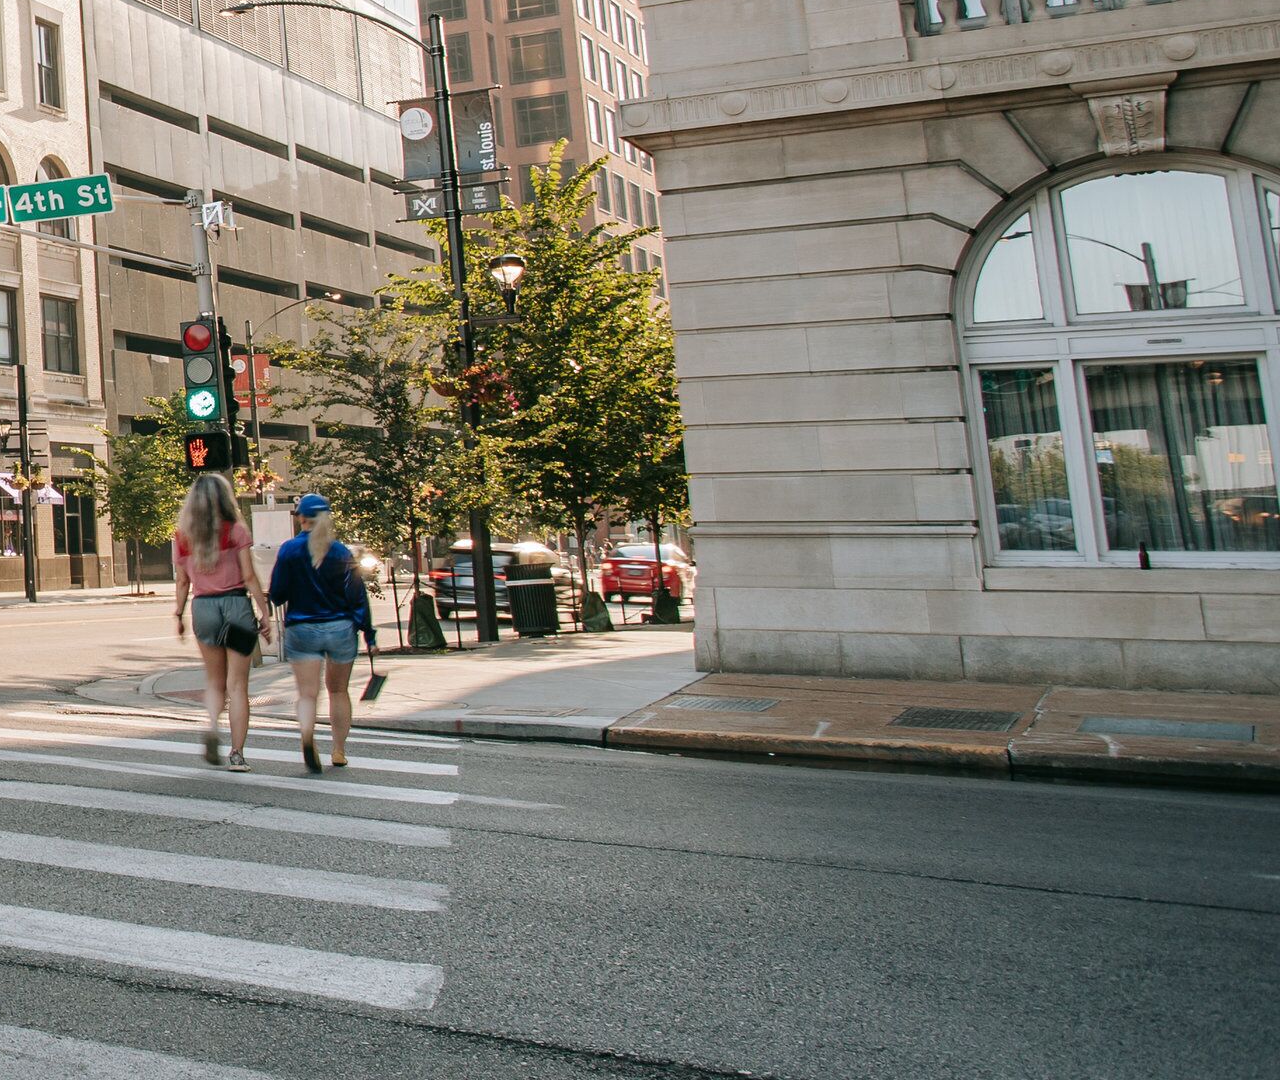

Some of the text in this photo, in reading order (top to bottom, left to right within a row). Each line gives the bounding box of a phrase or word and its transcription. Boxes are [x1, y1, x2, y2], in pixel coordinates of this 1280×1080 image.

[477, 122, 494, 170] st. louis
[15, 183, 108, 214] 4th St
